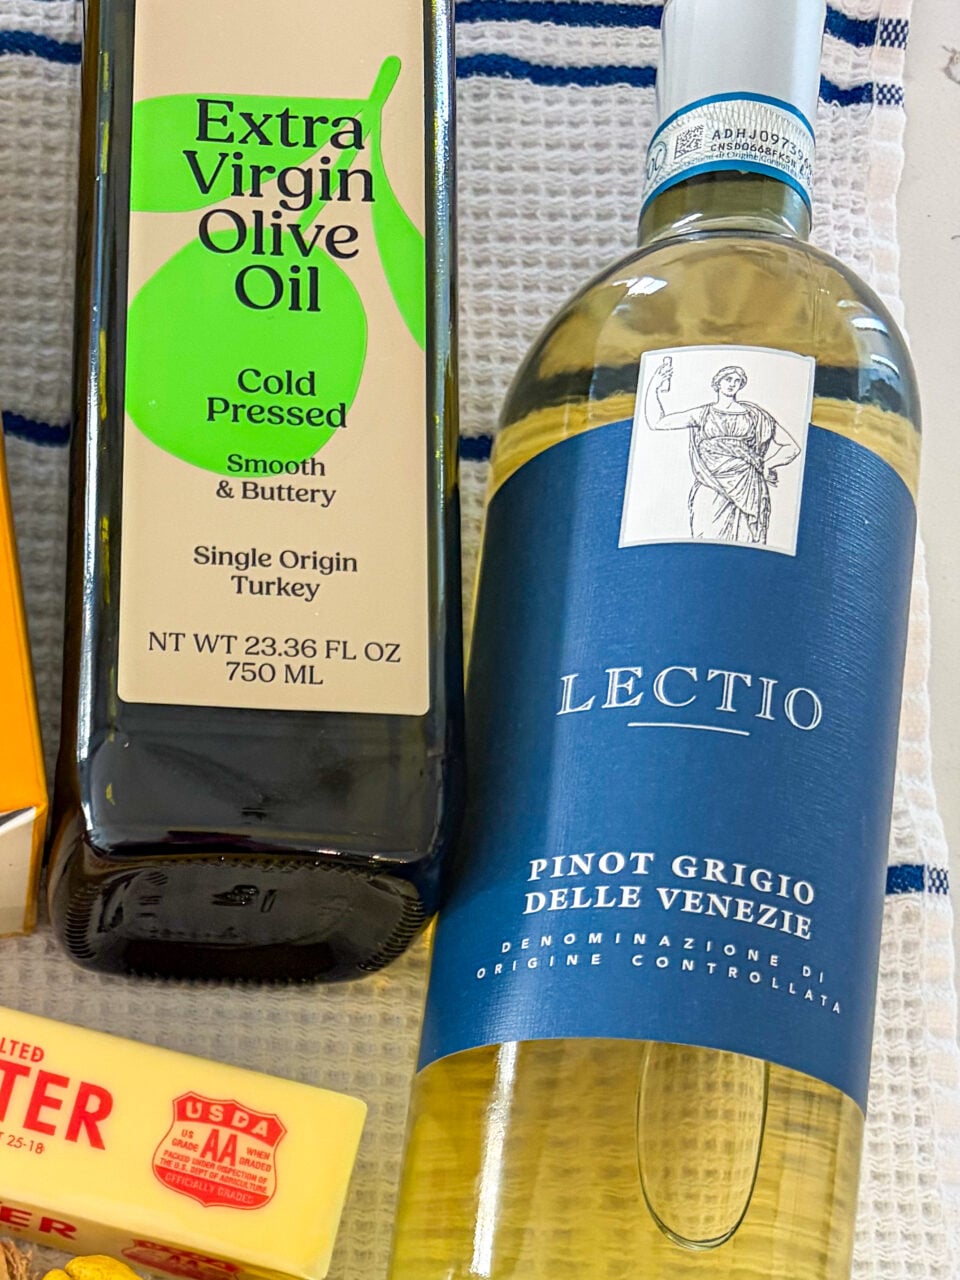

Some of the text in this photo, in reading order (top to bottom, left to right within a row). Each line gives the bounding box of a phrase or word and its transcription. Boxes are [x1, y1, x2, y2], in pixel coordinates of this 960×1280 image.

[196, 99, 365, 150] Extra
[184, 151, 375, 211] Virgin
[198, 209, 360, 260] Olive
[235, 264, 322, 313] Oil
[238, 368, 317, 397] Cold
[206, 397, 348, 428] Pressed
[227, 453, 326, 478] Smooth
[216, 481, 337, 508] & Buttery
[193, 546, 359, 576] Single Origin
[231, 575, 321, 602] Turkey
[148, 632, 402, 664] NT WT 23.36 FL OZ
[226, 662, 324, 687] 750 ML
[556, 665, 823, 732] LECTIO
[528, 852, 815, 906] PINOT GRIGIO
[522, 886, 813, 941] DELLE VENEZIE
[501, 932, 824, 983] DENOMINAZIONE DI
[476, 952, 841, 1015] ORIGINE CONTROLLATA
[181, 1129, 195, 1140] US
[185, 1100, 270, 1138] USDA
[6, 1133, 46, 1156] 25-18
[171, 1138, 199, 1153] GRADE
[199, 1128, 239, 1168] AA
[246, 1147, 271, 1161] WHEN
[159, 1157, 268, 1194] THE U.S. DEPT AGRICULTURE
[163, 1149, 258, 1183] PACKED UNDER INSPECTION
[239, 1156, 272, 1173] GRADED
[164, 1172, 255, 1205] OFFICIALLY GRADED
